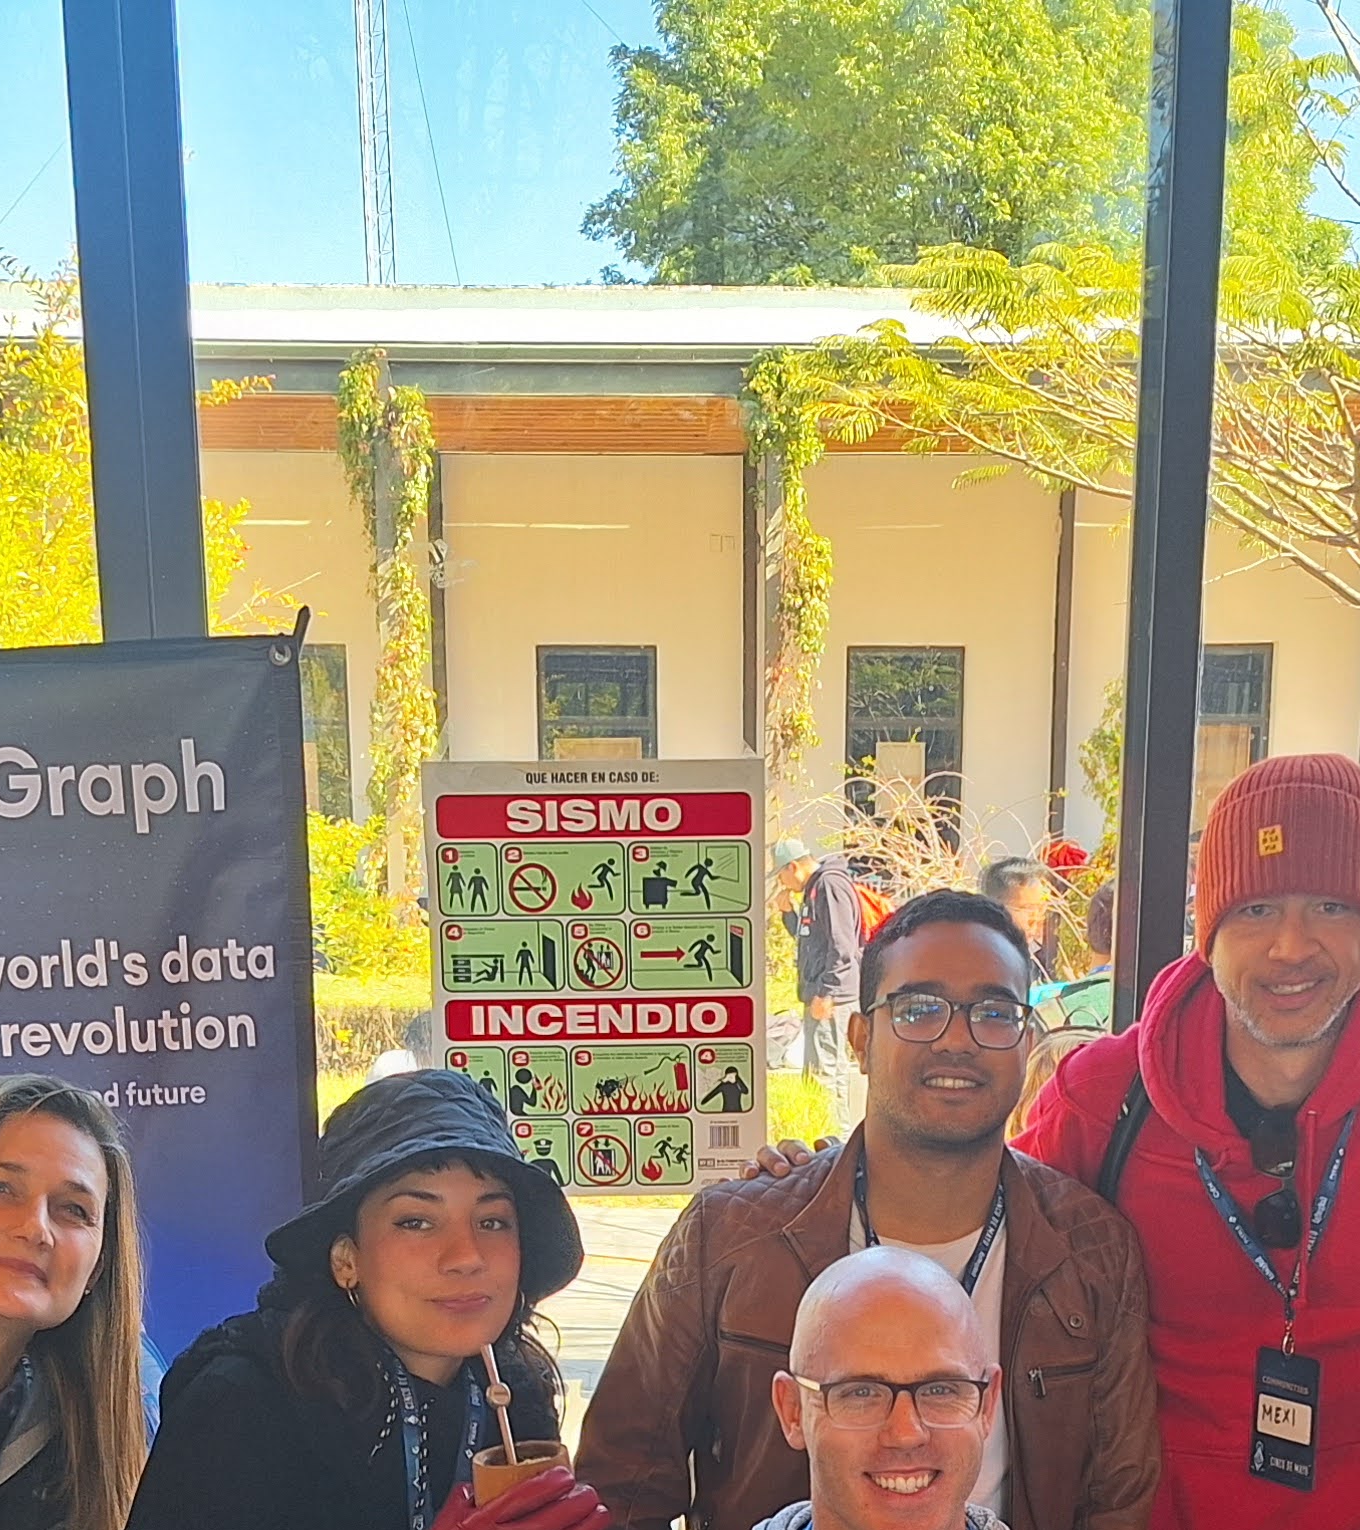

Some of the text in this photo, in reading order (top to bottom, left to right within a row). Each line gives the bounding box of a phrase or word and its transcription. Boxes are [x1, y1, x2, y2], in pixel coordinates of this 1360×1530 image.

[525, 771, 660, 785] QUE HACER EN CASO DE:
[506, 798, 683, 833] SISMO
[507, 849, 520, 860] 2
[635, 848, 647, 859] 3
[446, 927, 460, 939] 4
[573, 926, 585, 937] 5
[160, 934, 276, 983] data
[471, 1001, 729, 1037] INCENDIO
[0, 1002, 259, 1058] revolution
[515, 1053, 527, 1065] 2
[578, 1052, 590, 1064] 3
[701, 1051, 713, 1062] 4
[125, 1081, 206, 1108] future
[579, 1124, 591, 1136] 7
